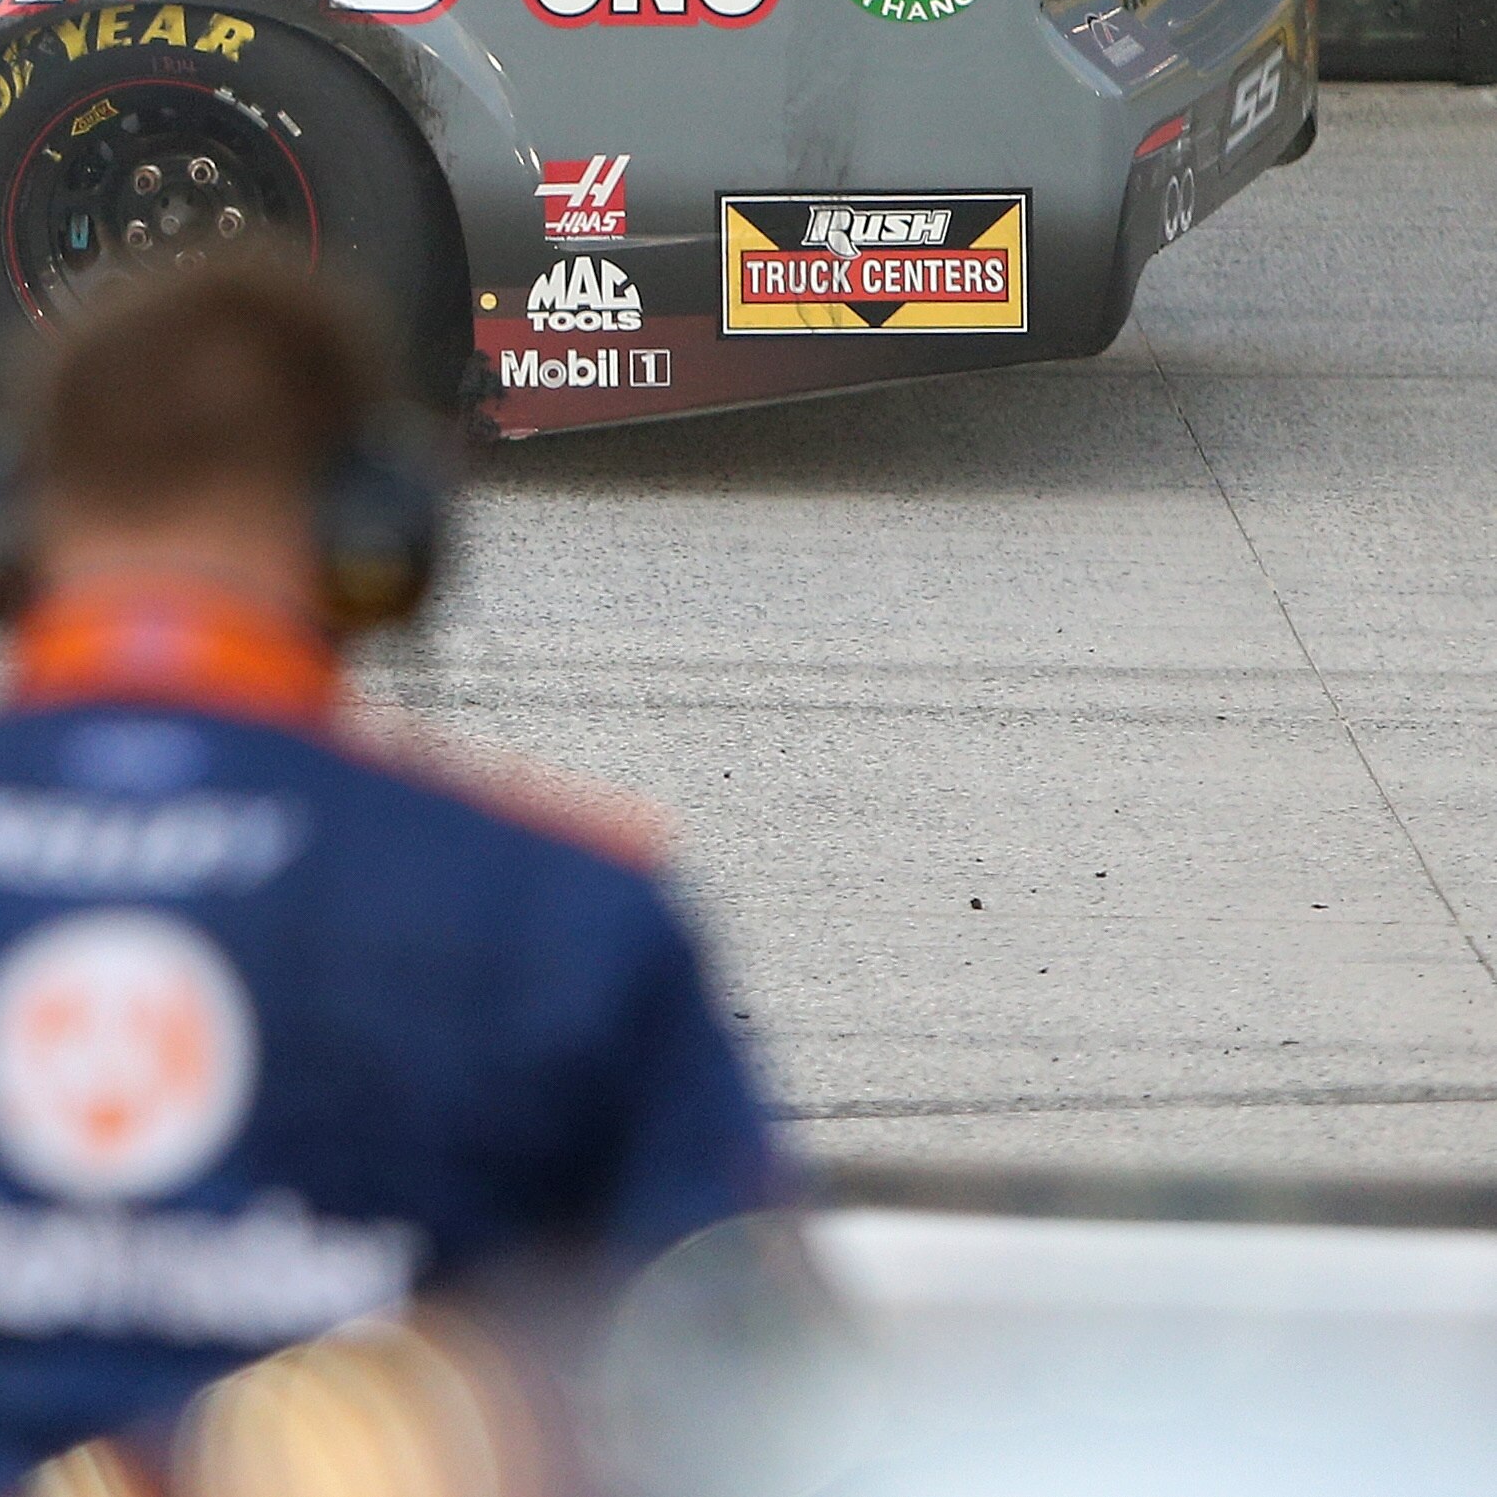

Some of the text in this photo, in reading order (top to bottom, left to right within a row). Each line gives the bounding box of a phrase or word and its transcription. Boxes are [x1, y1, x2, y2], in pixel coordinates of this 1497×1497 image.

[544, 210, 627, 234] HAAS
[526, 255, 643, 311] MAC
[746, 258, 1005, 294] TRUCK CENTERS
[526, 310, 643, 332] TOOLS
[500, 348, 620, 389] Mobil
